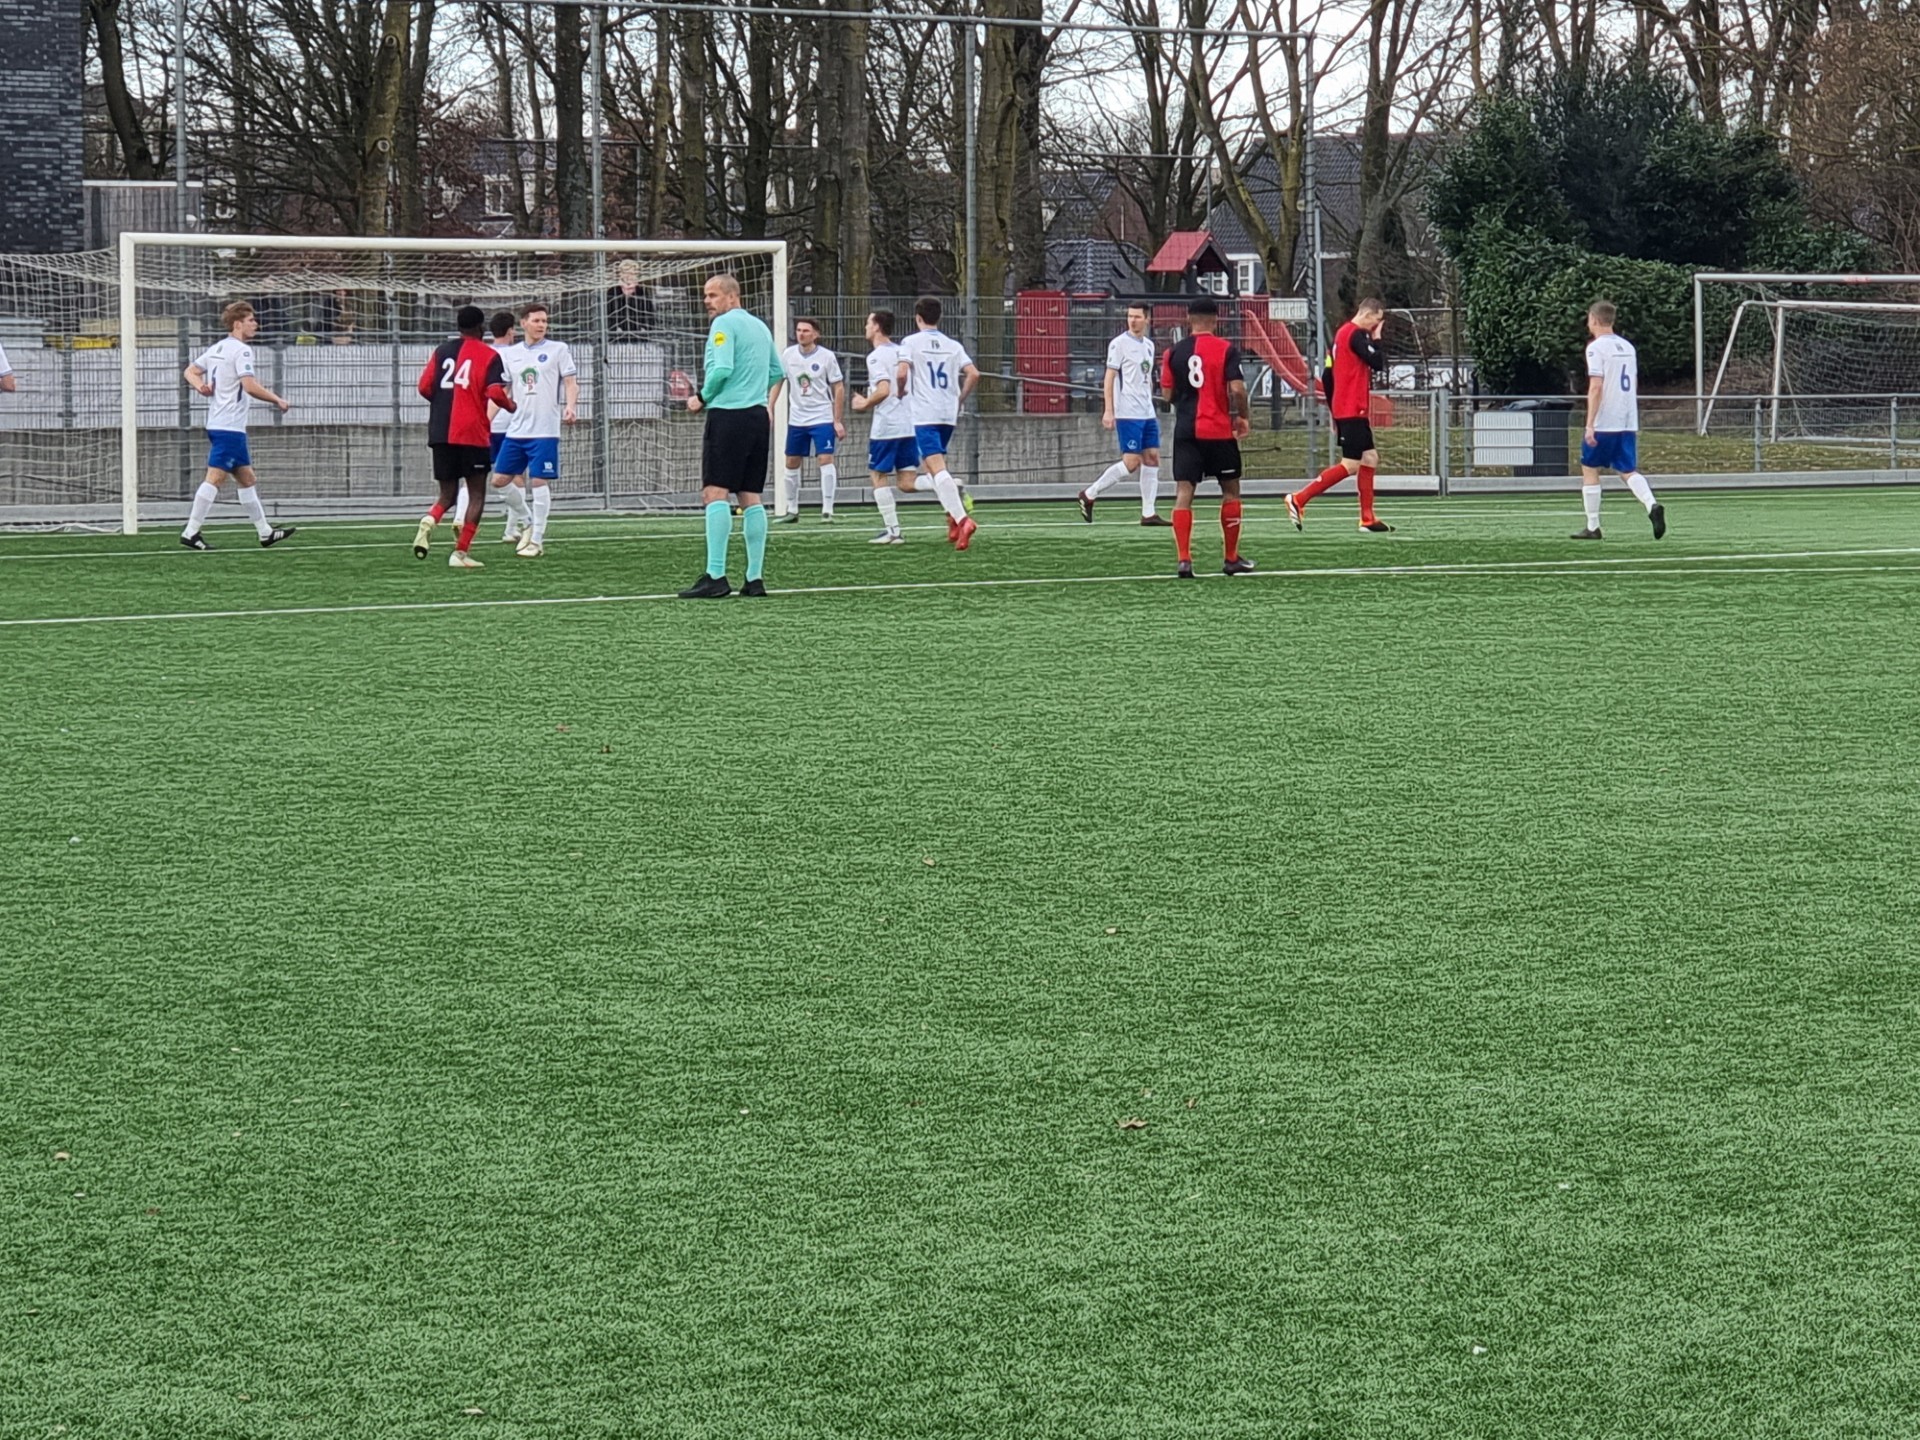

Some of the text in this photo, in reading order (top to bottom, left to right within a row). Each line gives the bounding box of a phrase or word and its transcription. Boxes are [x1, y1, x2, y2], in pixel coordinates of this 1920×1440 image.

[440, 358, 472, 390] 24
[927, 361, 948, 389] 16
[1187, 354, 1204, 389] 8
[1620, 364, 1631, 392] 6
